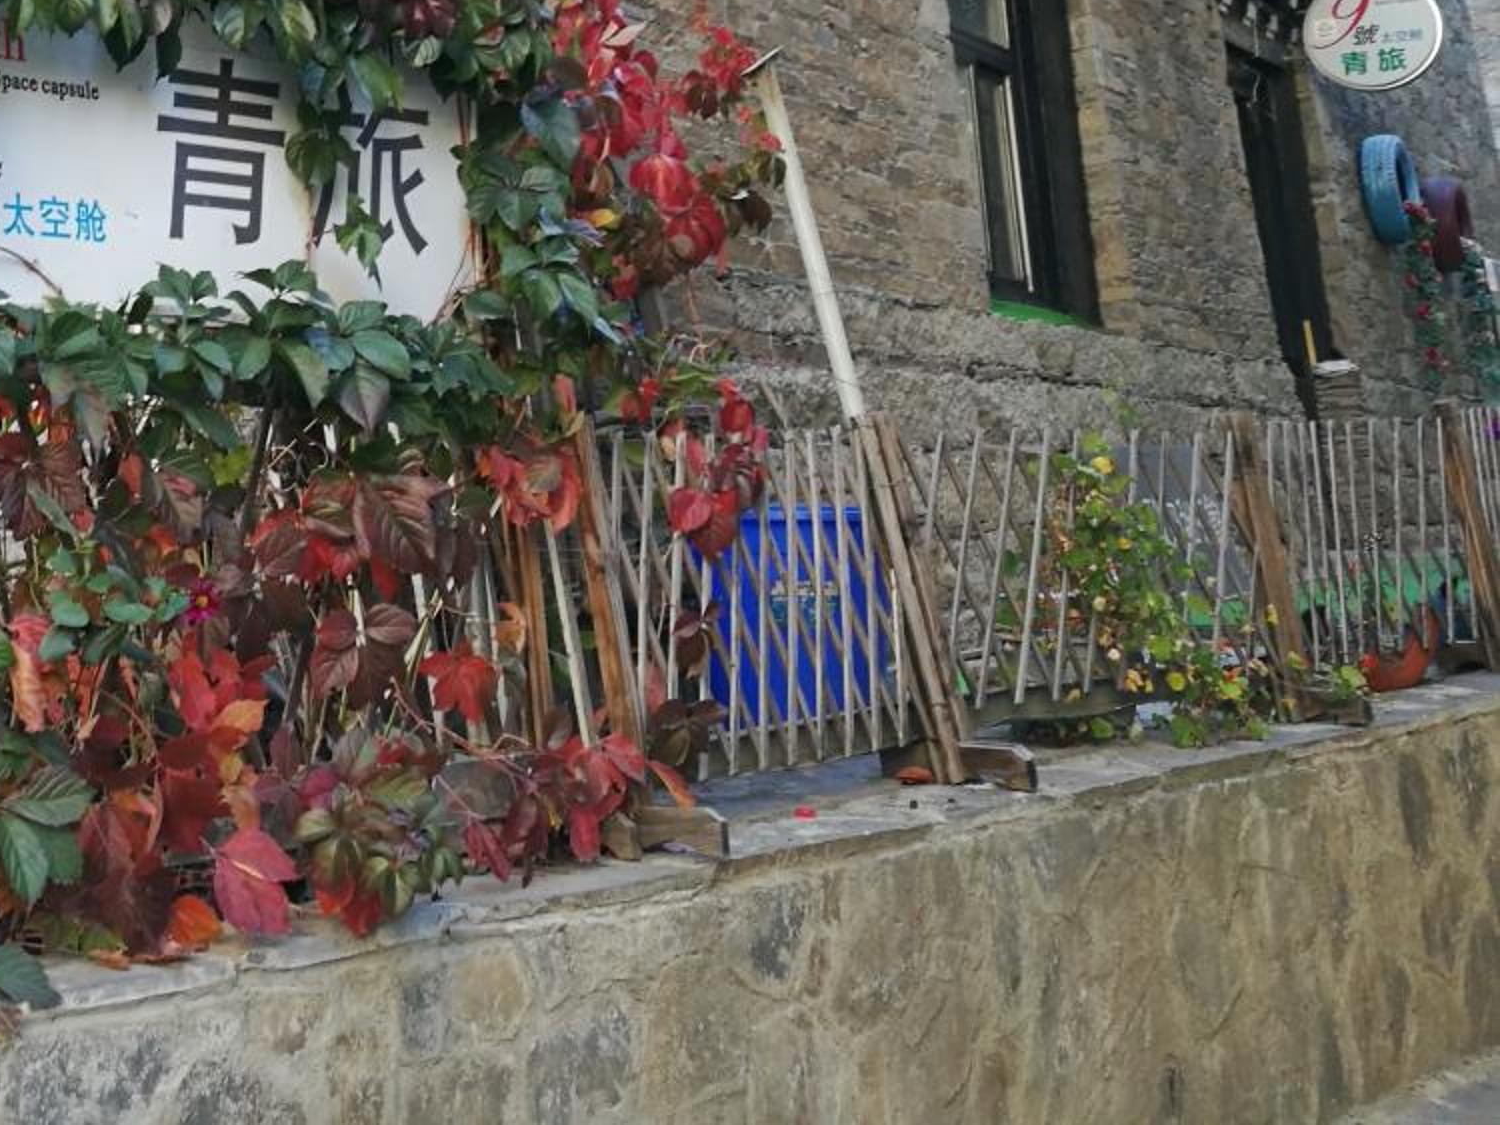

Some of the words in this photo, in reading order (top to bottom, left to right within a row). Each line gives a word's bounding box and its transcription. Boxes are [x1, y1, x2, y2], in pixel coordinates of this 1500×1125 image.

[1342, 48, 1407, 75] 青旅
[41, 78, 100, 101] capsule
[157, 58, 429, 256] 青旅
[3, 192, 107, 243] 太空舱
